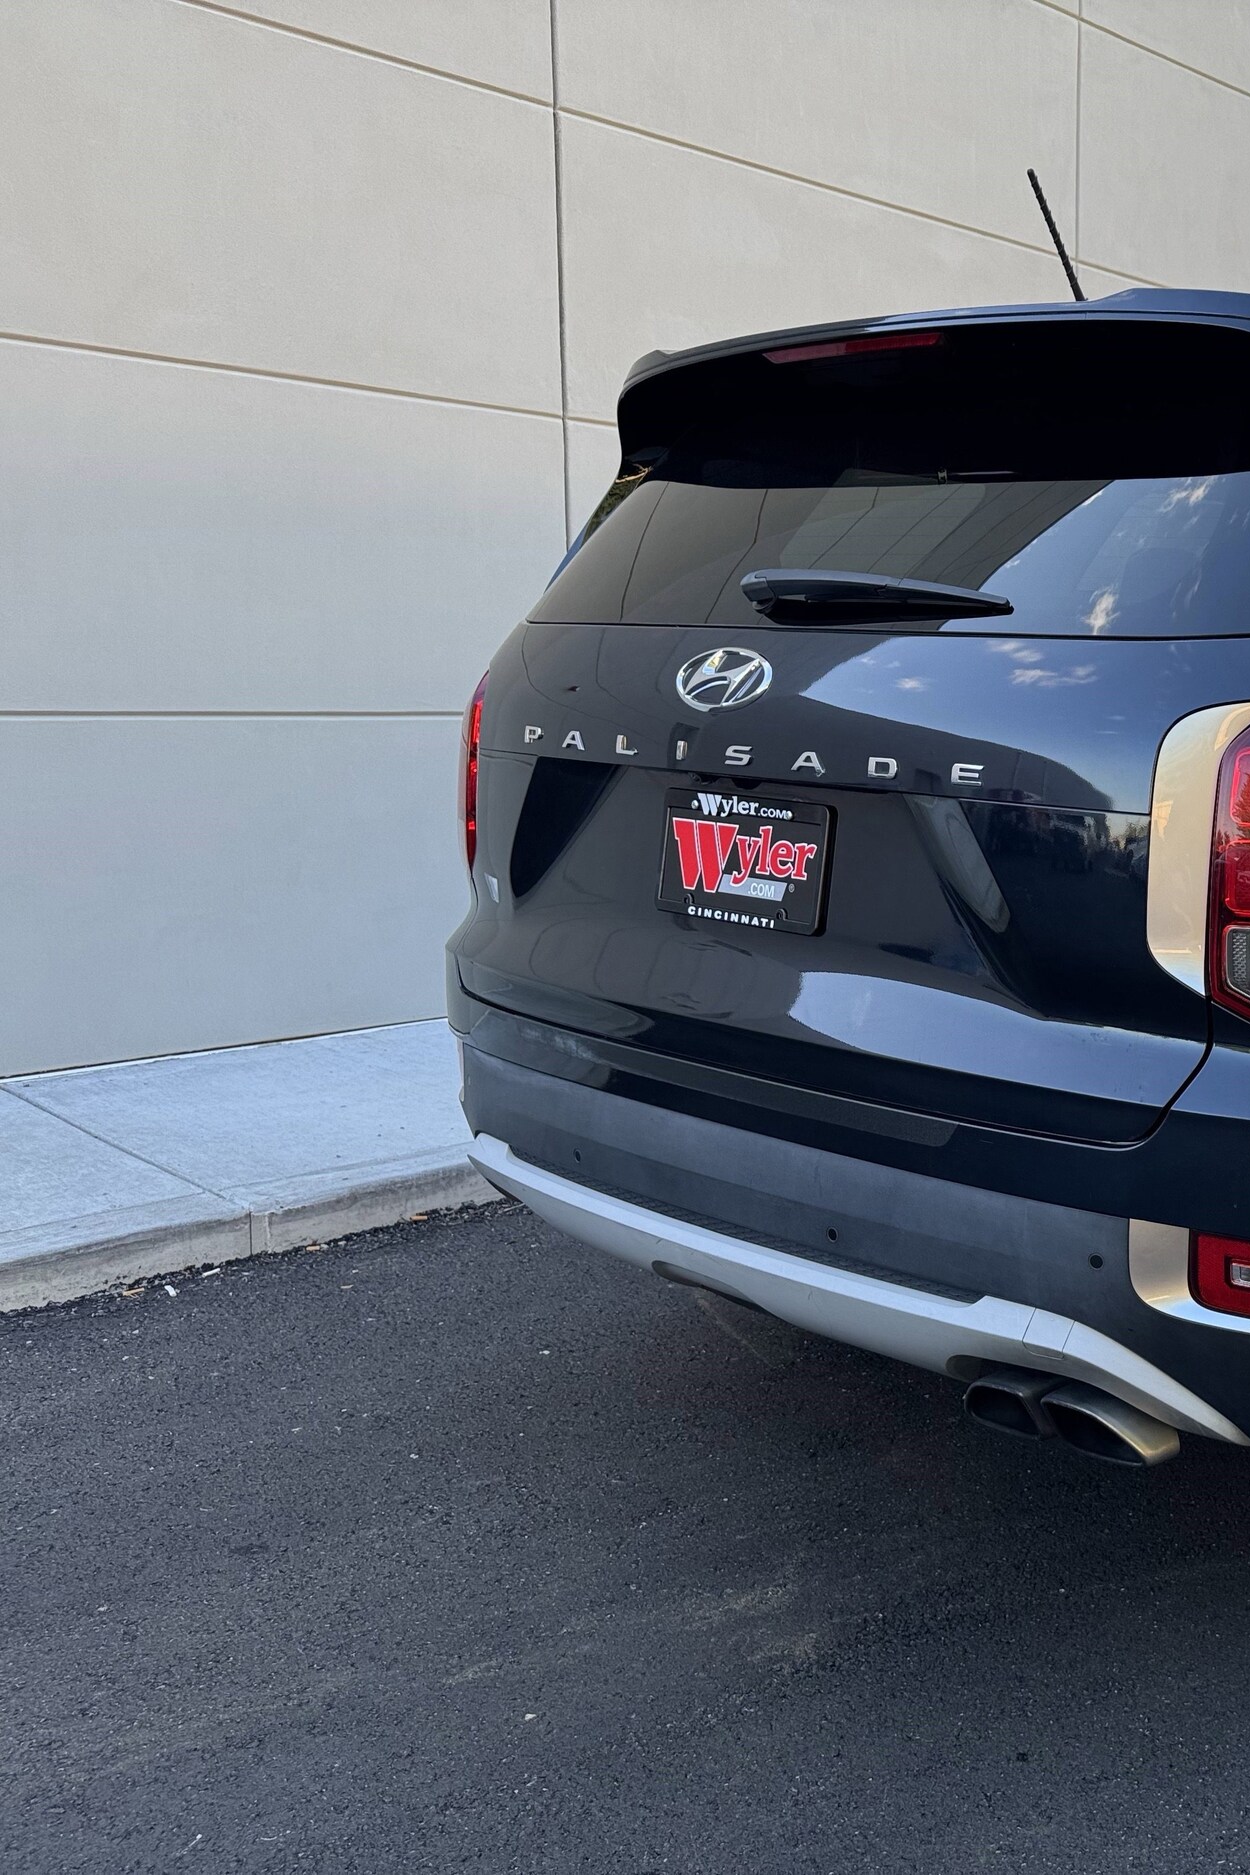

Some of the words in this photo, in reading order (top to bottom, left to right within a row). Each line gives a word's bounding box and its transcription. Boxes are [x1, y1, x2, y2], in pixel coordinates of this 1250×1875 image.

[524, 725, 985, 787] PALISADE
[672, 816, 818, 894] Wyler
[687, 905, 775, 929] CINCINNATI
